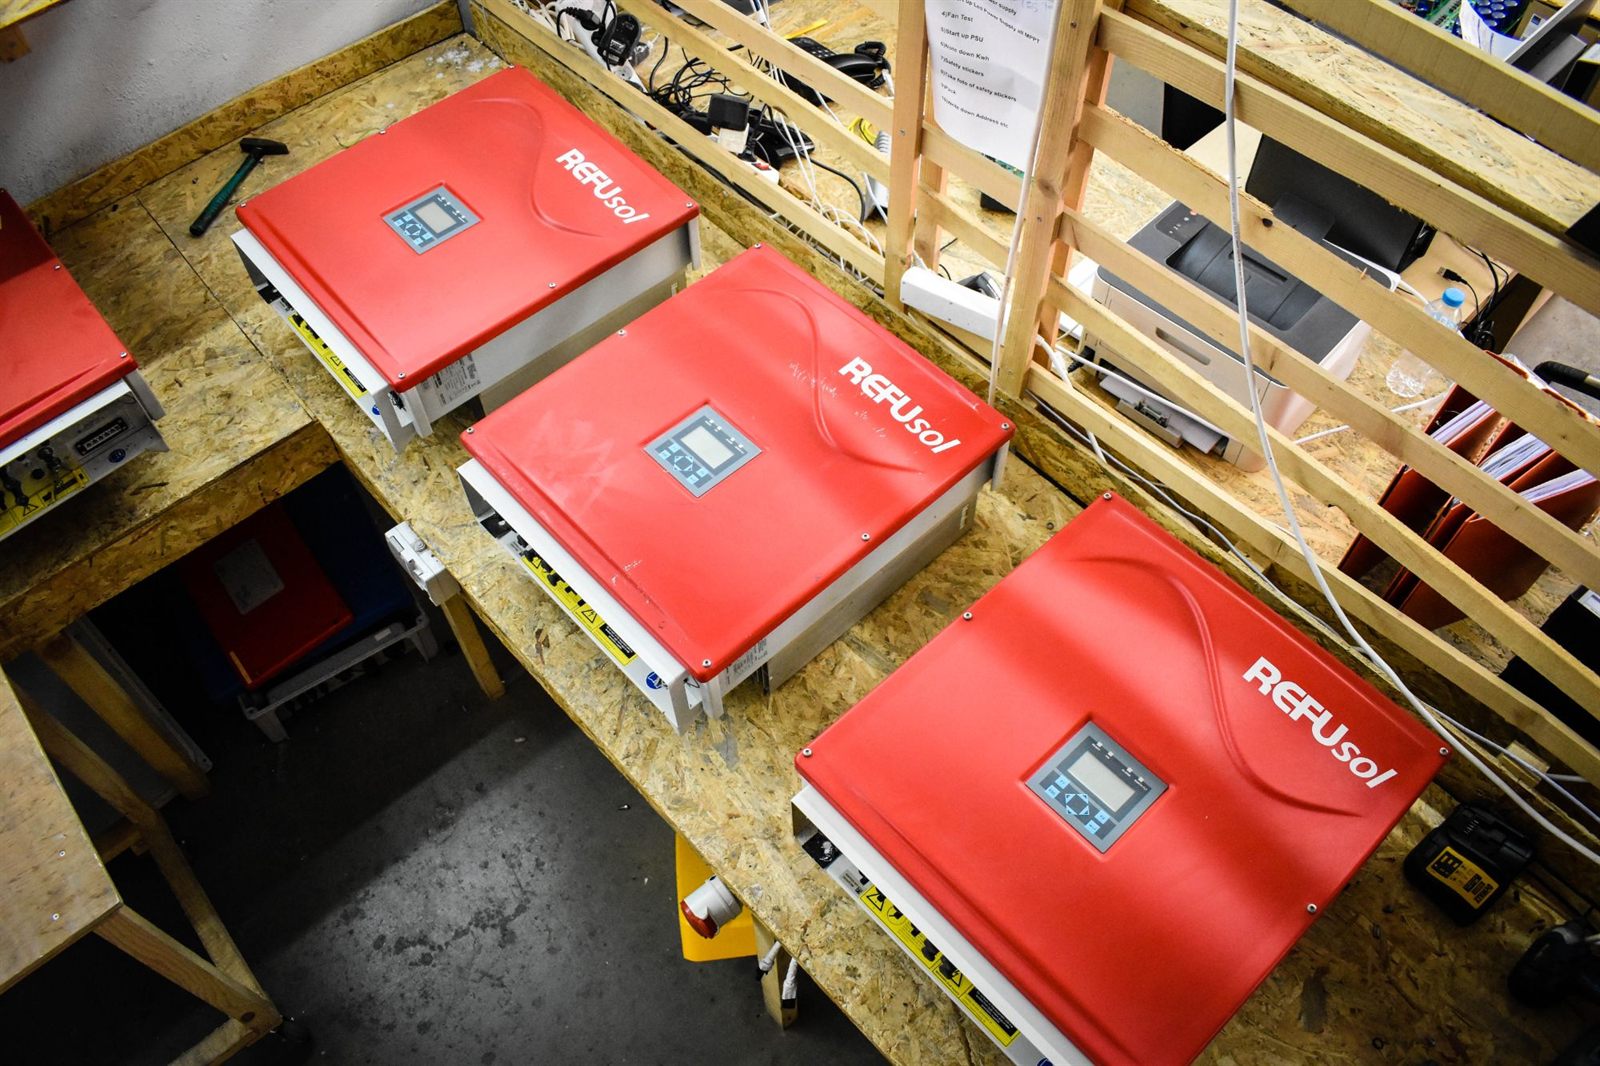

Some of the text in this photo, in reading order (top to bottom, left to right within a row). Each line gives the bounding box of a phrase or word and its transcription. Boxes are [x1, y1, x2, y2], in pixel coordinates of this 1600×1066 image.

[961, 14, 973, 22] Test
[970, 34, 984, 43] PSU
[959, 49, 974, 57] down
[976, 53, 990, 61] Kwh
[962, 65, 985, 77] stickers
[957, 77, 968, 86] foto
[976, 85, 993, 95] safety
[994, 91, 1017, 102] stickers
[960, 107, 975, 116] down
[976, 113, 999, 125] Address
[554, 147, 651, 225] REFUsol
[838, 355, 962, 454] REFUsol
[1242, 655, 1398, 789] REFUsol
